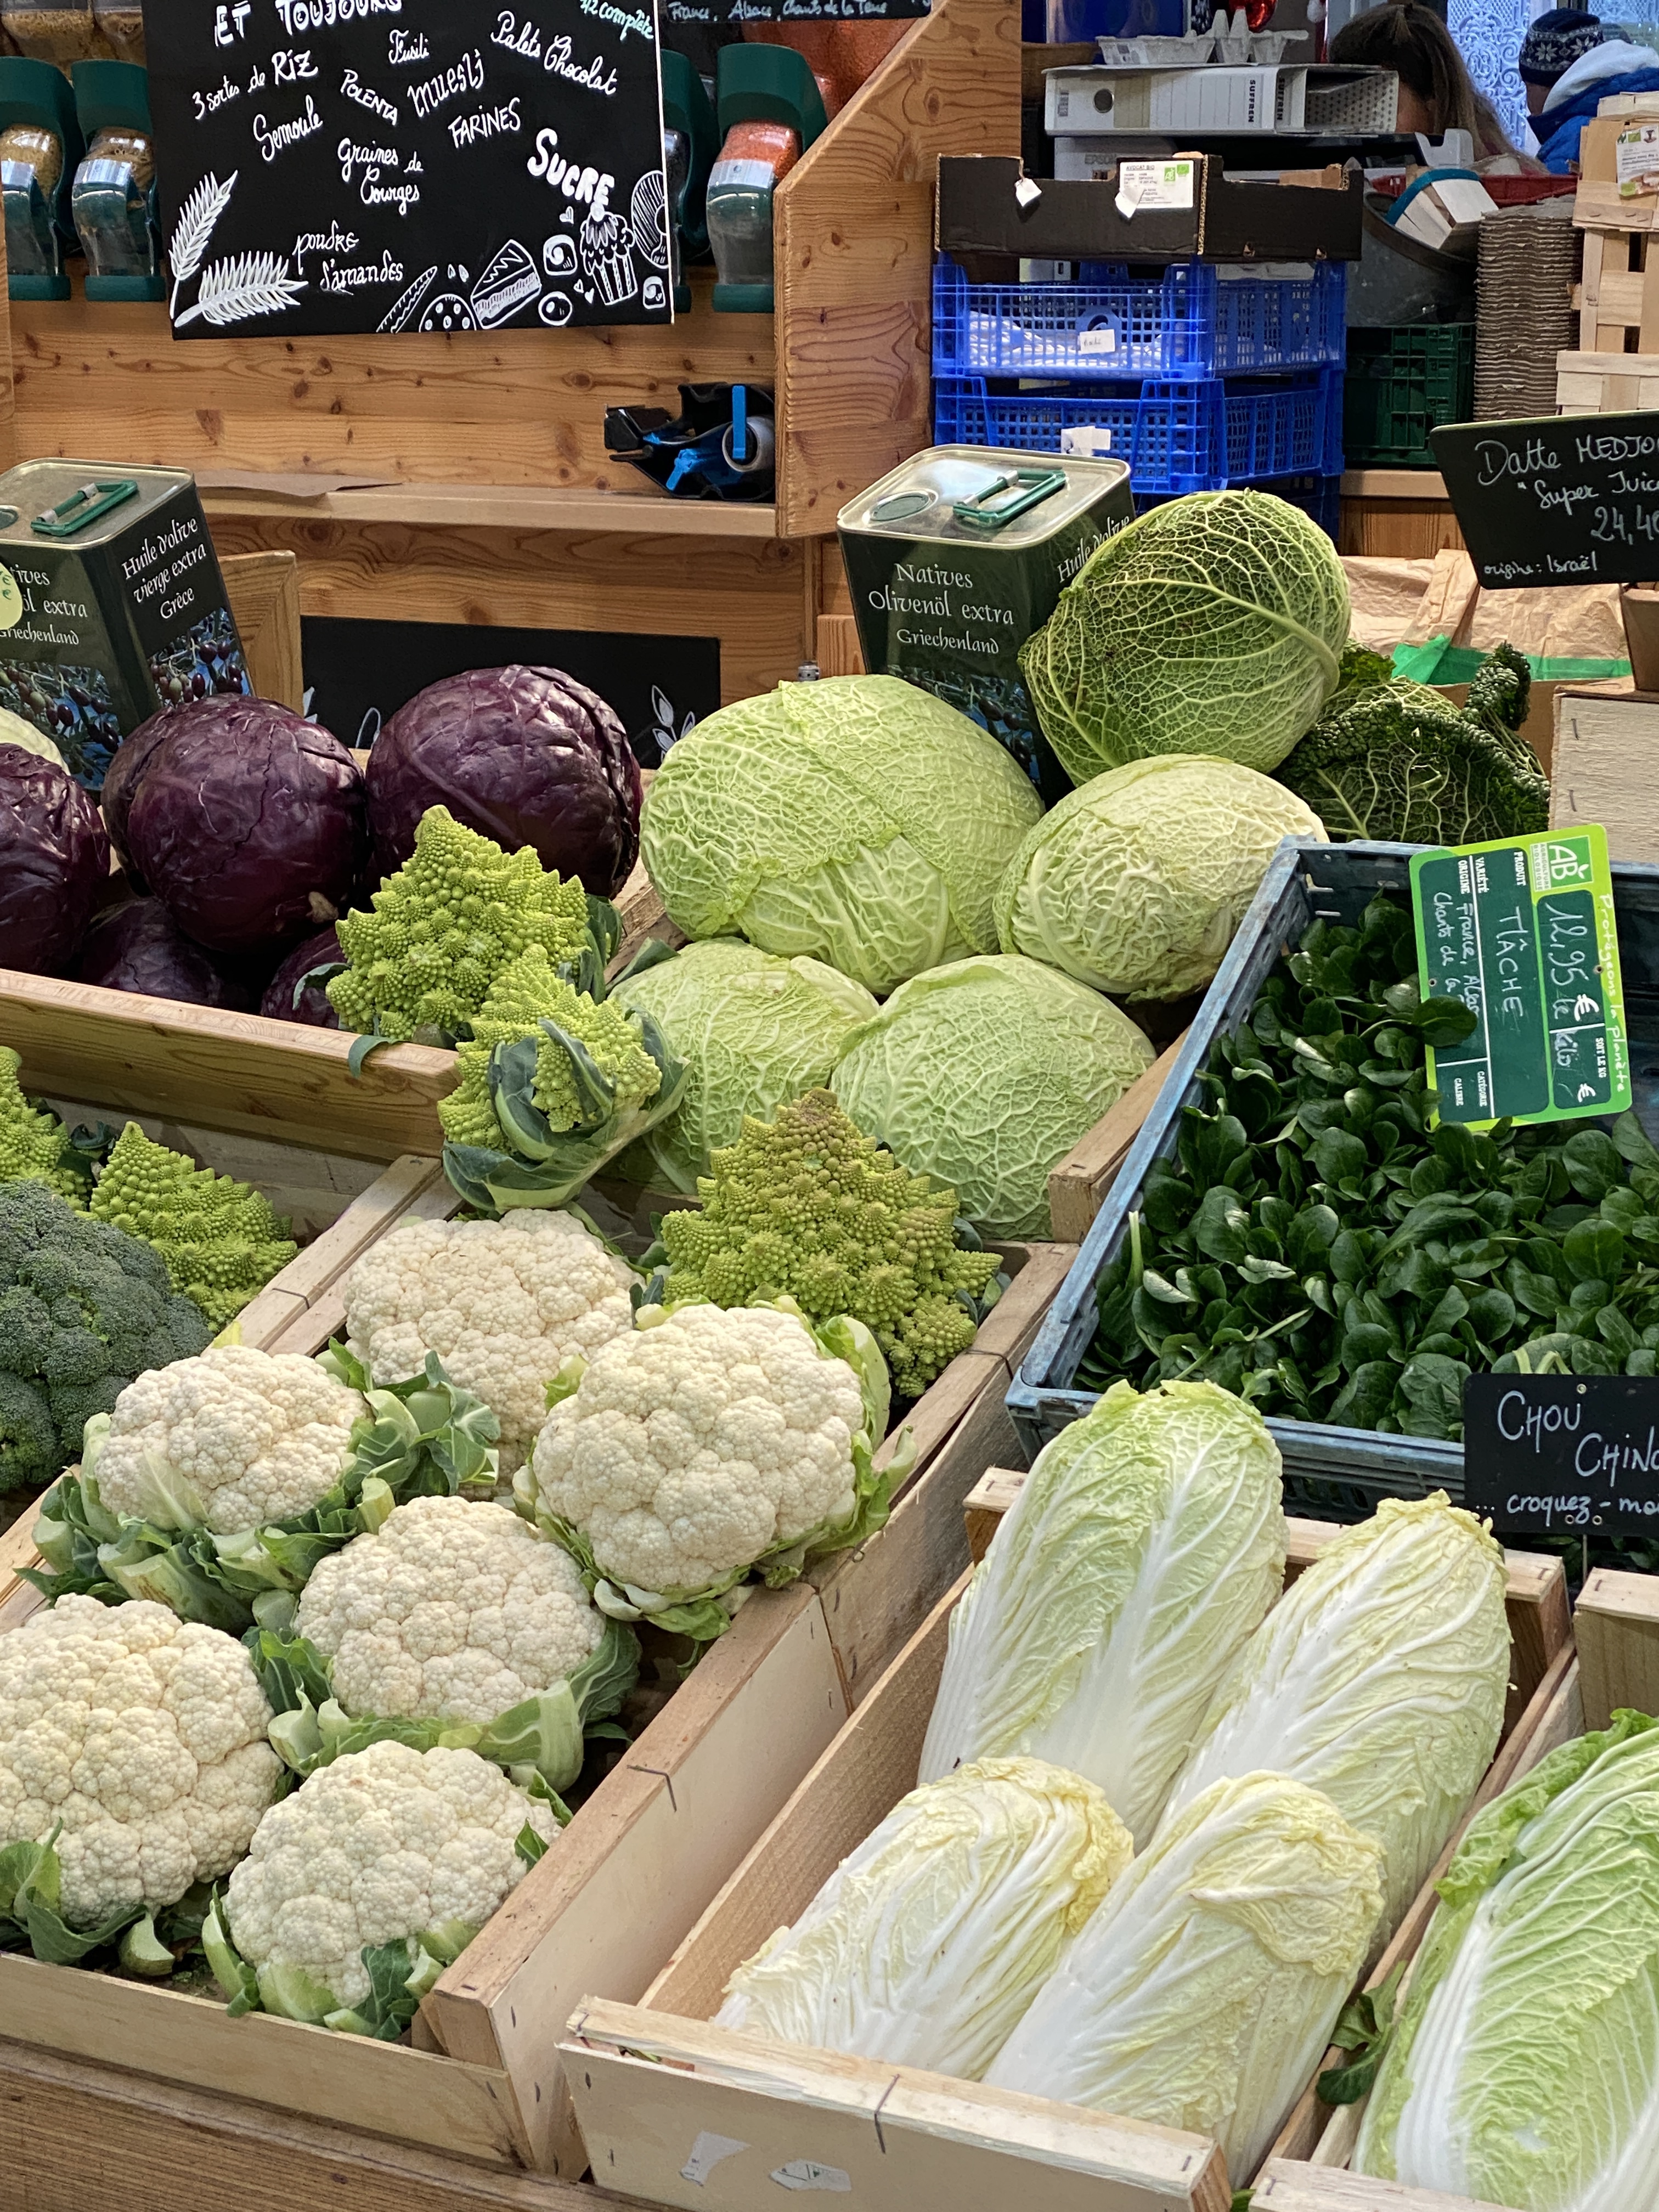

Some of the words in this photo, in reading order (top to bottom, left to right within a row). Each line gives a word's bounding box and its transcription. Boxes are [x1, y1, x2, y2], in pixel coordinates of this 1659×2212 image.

[215, 0, 251, 47] ET
[490, 10, 541, 59] Palets
[544, 35, 619, 95] Chocolat
[192, 92, 205, 120] 3
[206, 75, 240, 111] sortes
[247, 65, 266, 93] de
[340, 69, 398, 126] POLENTA
[1277, 78, 1285, 120] SUFFREN
[253, 94, 323, 162] Semoule
[448, 97, 521, 149] FARINES
[337, 138, 399, 183] Graines
[403, 151, 424, 173] de
[360, 165, 420, 215] Courges
[1475, 439, 1561, 486] Datte
[1575, 434, 1659, 463] MEDJO
[1607, 470, 1659, 493] Juic
[121, 538, 158, 580] Huile
[156, 518, 198, 555] d'olive
[1057, 537, 1091, 584] Huile
[1547, 551, 1598, 572] Israël
[10, 563, 50, 585] tives
[133, 568, 171, 603] vierge
[171, 543, 206, 577] extra
[894, 563, 973, 589] Natives
[43, 599, 88, 618] extra
[160, 588, 195, 619] Grèce
[868, 585, 952, 617] Olivenöl
[962, 601, 1015, 626] extra
[896, 627, 1000, 654] Griechenland
[1458, 860, 1471, 895] ORIGINE
[1475, 856, 1490, 894] VARIÉTÉ
[1514, 851, 1526, 886] PRODUIT
[1533, 844, 1543, 891] BIOLOGIQUE
[1540, 843, 1550, 889] AGRICULTURE
[1549, 844, 1579, 880] AB
[1433, 891, 1455, 939] Chants
[1455, 902, 1475, 964] France,
[1440, 945, 1458, 967] de
[1544, 902, 1590, 986] 12,95
[1573, 993, 1600, 1022] €
[1463, 974, 1482, 1017] Alsac
[1595, 1037, 1605, 1054] SOIT
[1596, 1056, 1606, 1066] LE
[1454, 1077, 1464, 1107] CALIBRE
[1477, 1071, 1488, 1107] CATÉGORIE
[1598, 1067, 1607, 1078] KG
[1497, 1390, 1581, 1453] CHOU
